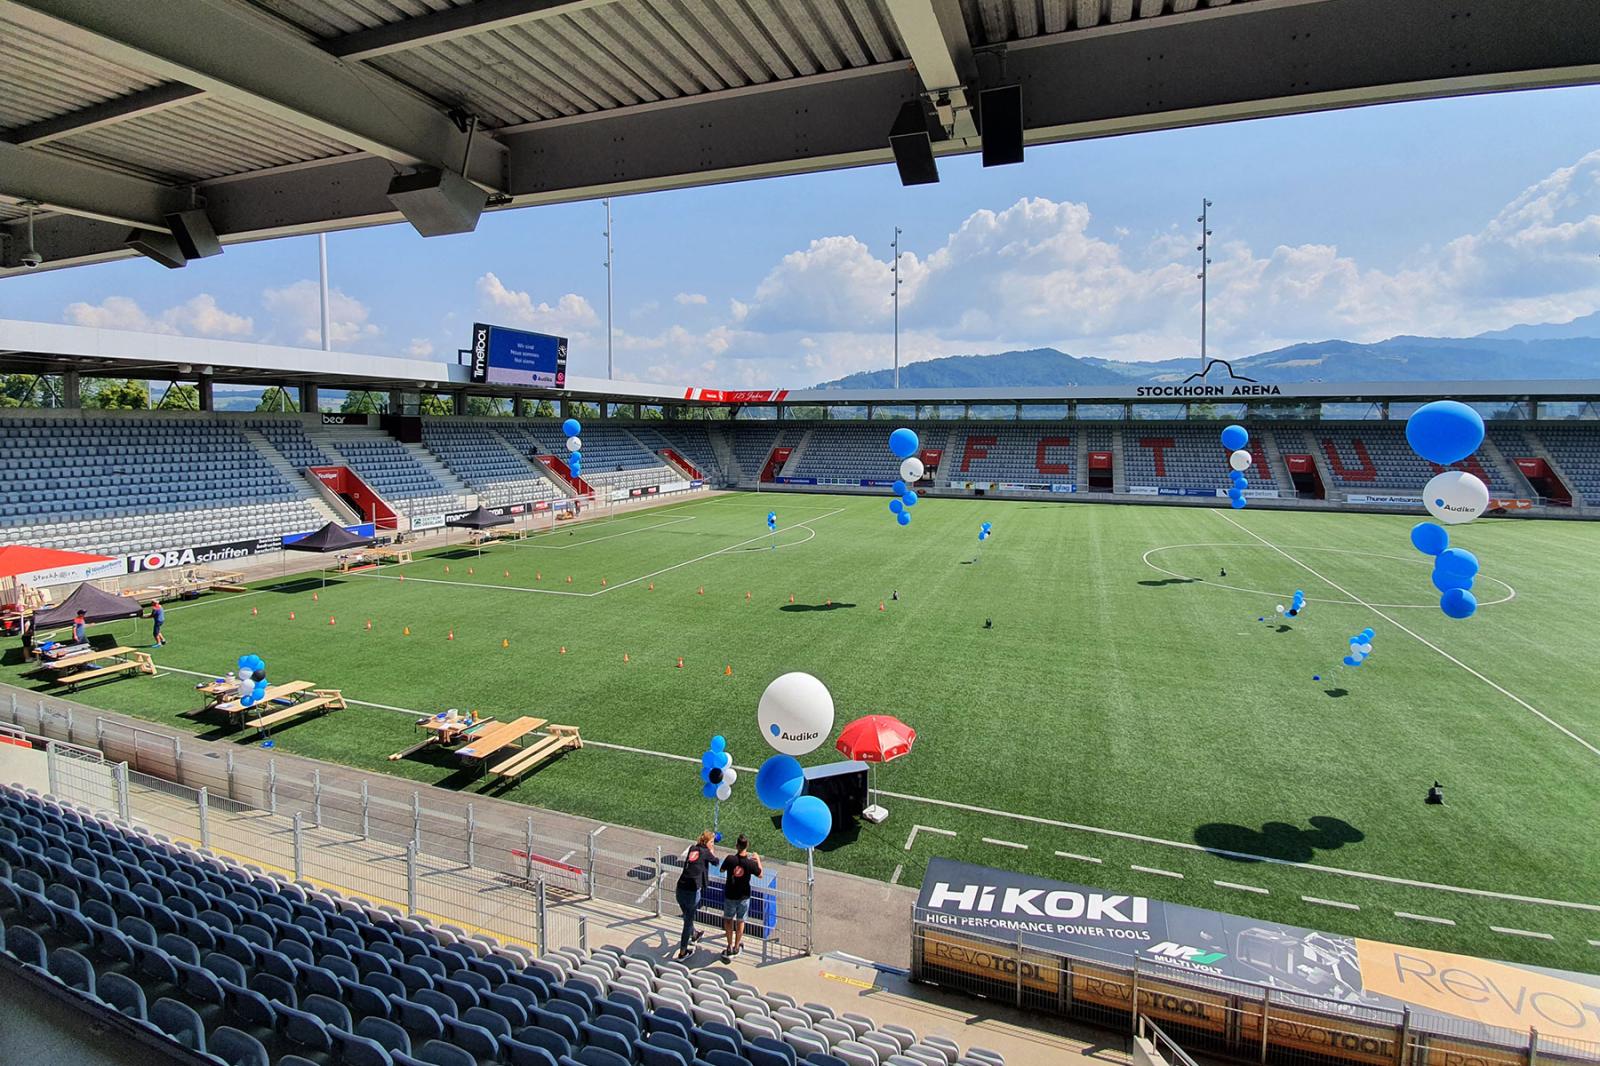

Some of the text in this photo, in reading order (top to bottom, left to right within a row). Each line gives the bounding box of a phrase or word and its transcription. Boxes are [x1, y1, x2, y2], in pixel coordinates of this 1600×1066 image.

[1136, 385, 1281, 396] STOCKHORN ARENA
[323, 414, 346, 424] bear
[1443, 504, 1475, 513] Audika
[197, 547, 249, 562] schriften
[781, 732, 818, 742] Audika
[926, 914, 1151, 940] HIGH PERFORMANCE POWER TOOLS
[1154, 955, 1190, 967] MULTI
[1192, 963, 1224, 975] VOLT
